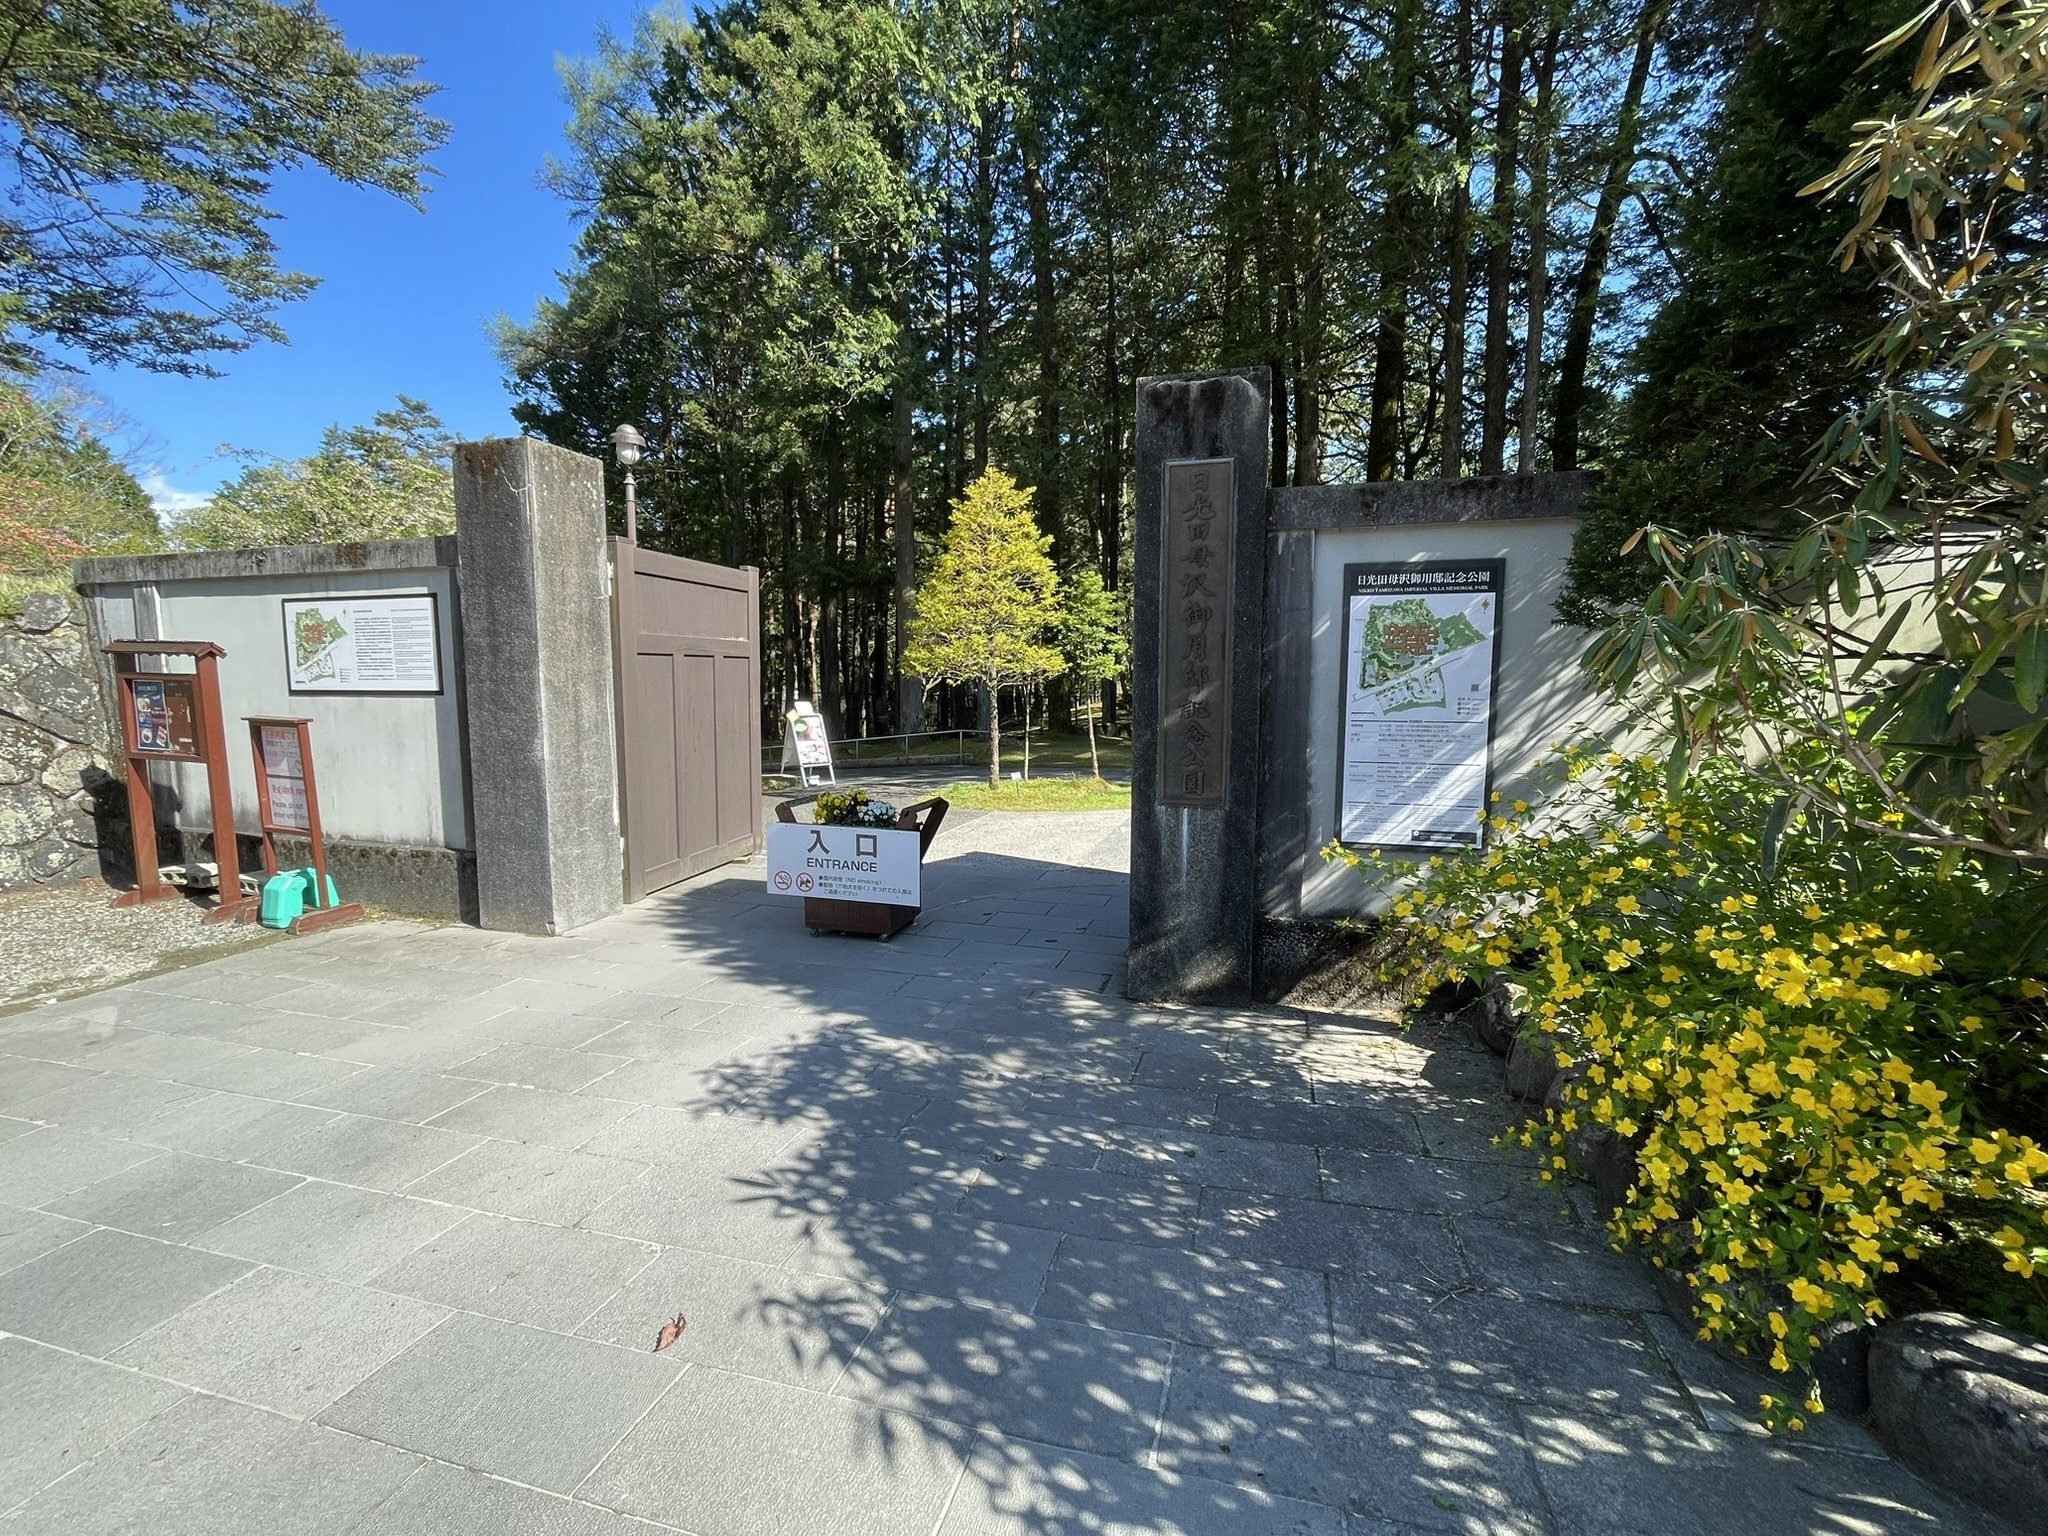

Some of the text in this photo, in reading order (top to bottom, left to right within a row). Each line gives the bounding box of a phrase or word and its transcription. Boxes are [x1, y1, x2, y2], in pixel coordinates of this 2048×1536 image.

[1358, 571, 1490, 586] 日光田母沢御用邸記念公園
[1178, 471, 1217, 795] 日光田母沢御用邸記念公園
[807, 830, 878, 858] 入口
[807, 858, 878, 872] ENTRANCE
